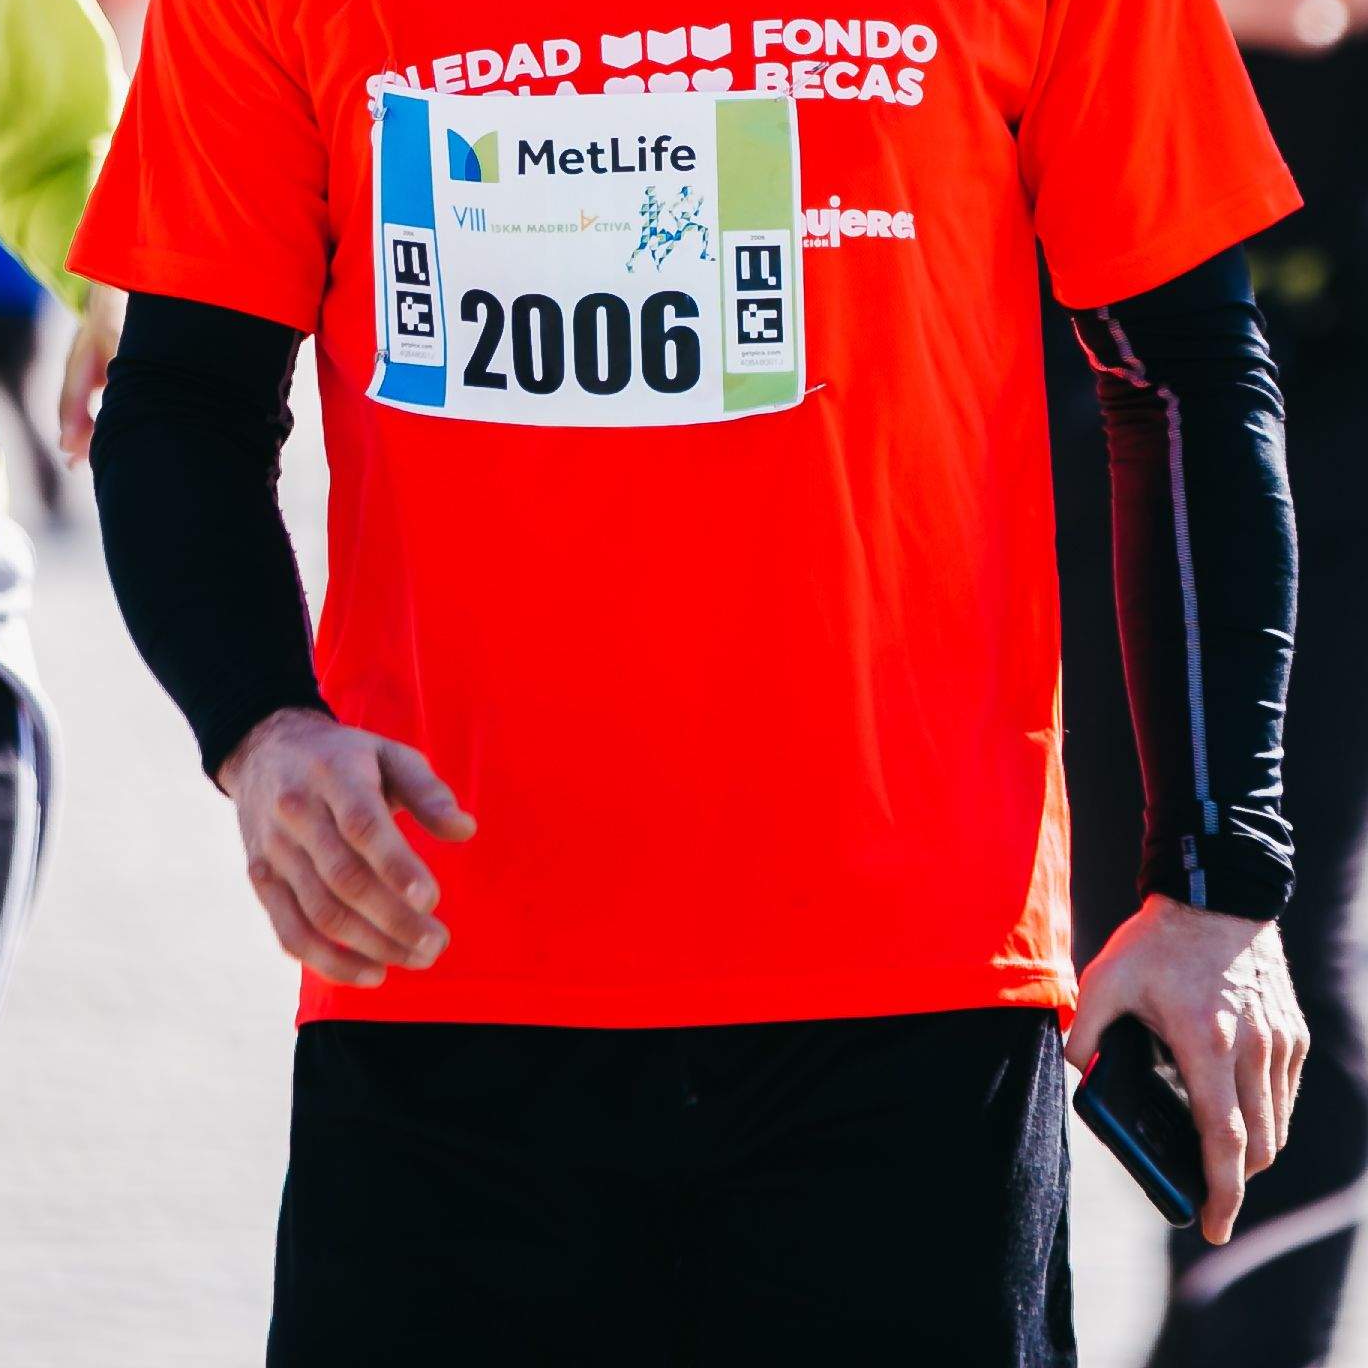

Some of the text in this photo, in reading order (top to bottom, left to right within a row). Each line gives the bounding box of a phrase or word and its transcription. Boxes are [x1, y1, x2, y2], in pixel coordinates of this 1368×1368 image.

[753, 18, 937, 63] FONDO
[755, 60, 925, 106] BECAS
[517, 135, 697, 177] MetLife
[453, 205, 487, 233] VIII
[526, 223, 578, 233] MADRID
[461, 288, 700, 395] 2006
